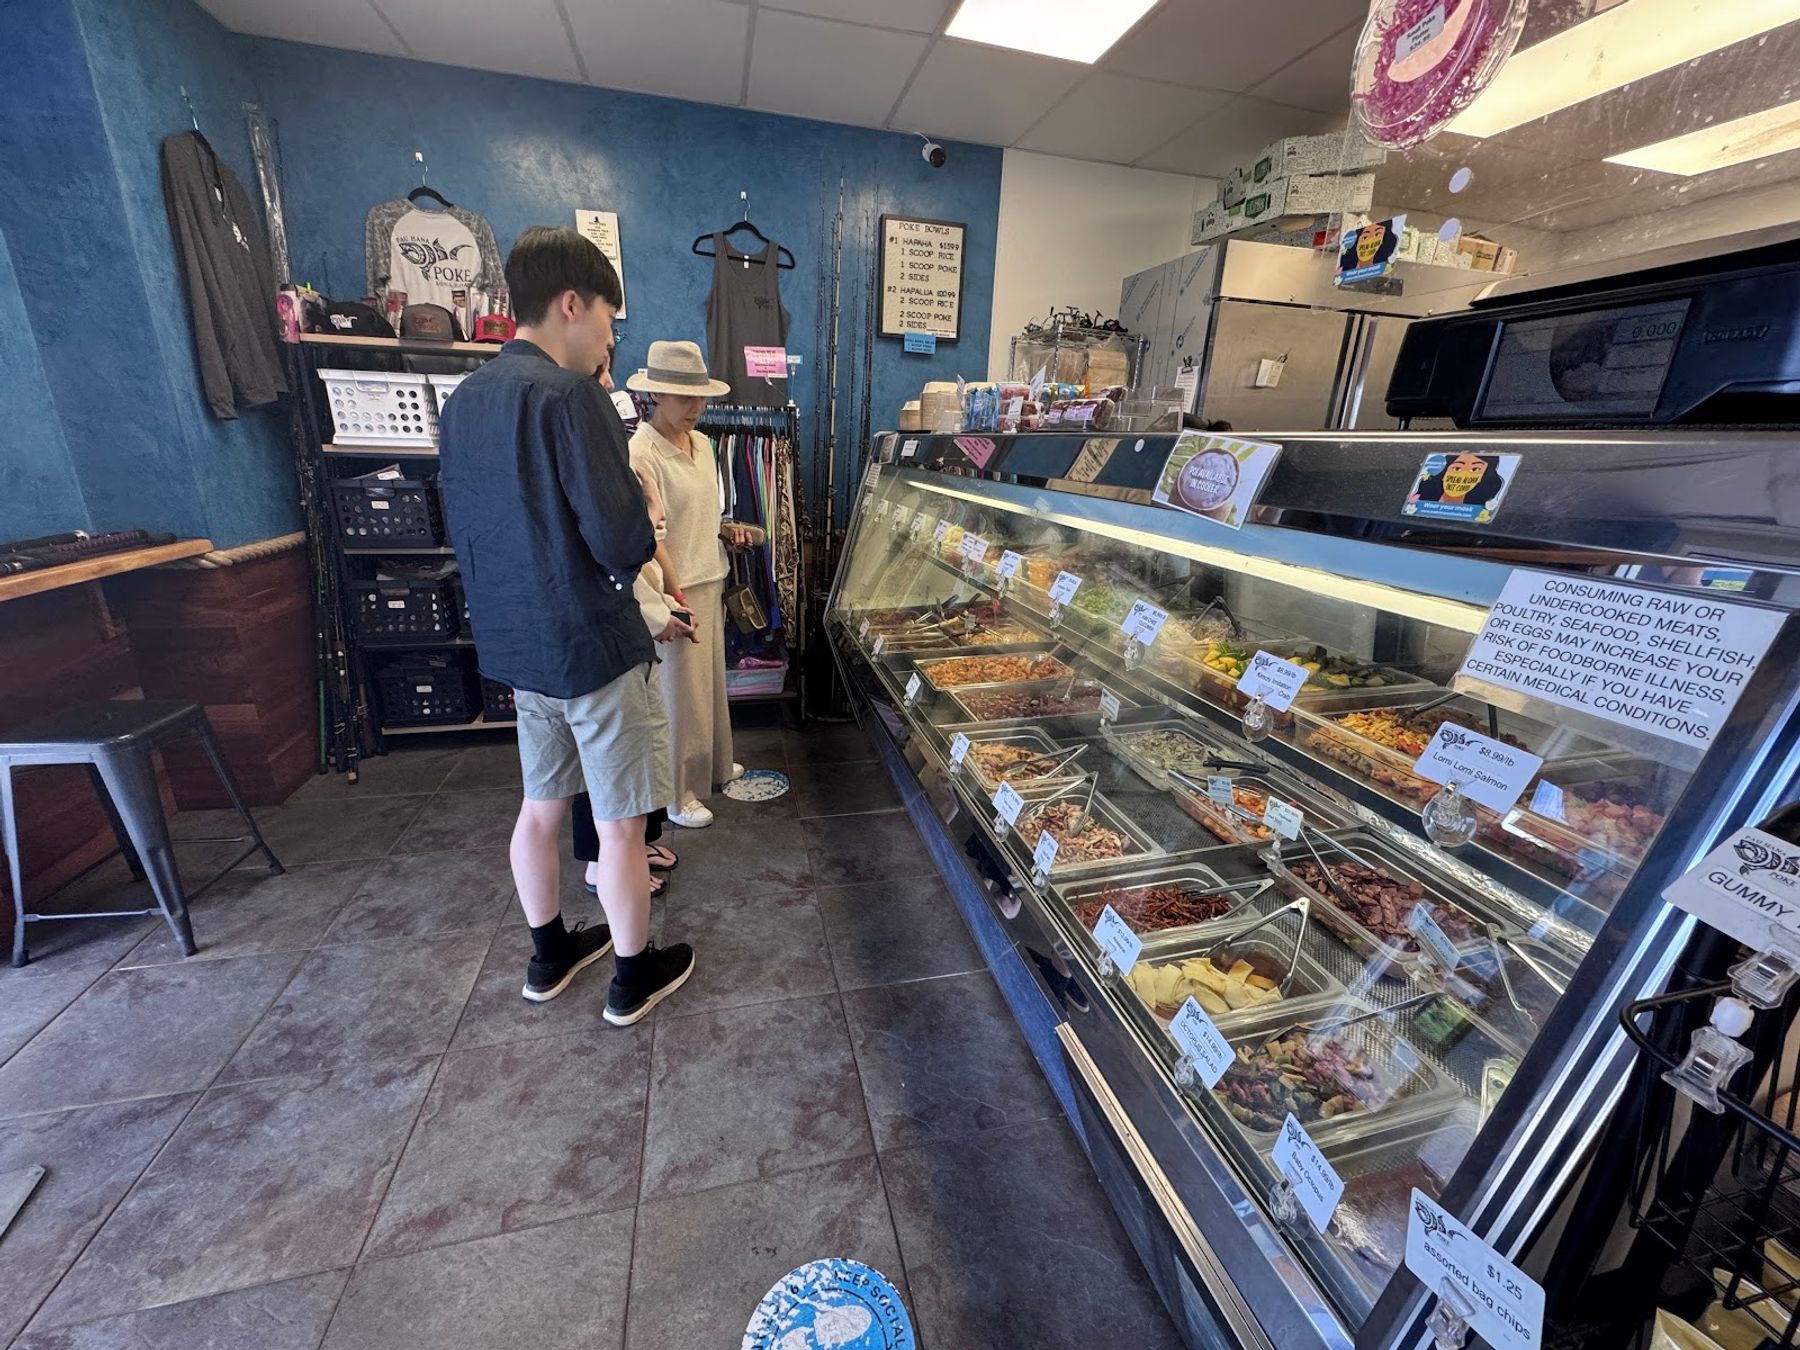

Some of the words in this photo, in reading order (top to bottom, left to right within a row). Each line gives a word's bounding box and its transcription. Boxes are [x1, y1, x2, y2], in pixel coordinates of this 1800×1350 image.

[898, 222, 920, 232] POKE
[924, 225, 950, 235] BOWLS
[901, 248, 905, 256] 1
[908, 248, 934, 258] SCOOP
[938, 252, 954, 261] RICE
[901, 260, 904, 268] 1
[908, 262, 934, 271] SCOOP
[938, 264, 958, 274] POKE
[433, 266, 472, 282] POKE
[900, 272, 905, 280] 2
[908, 274, 930, 282] SIDES
[900, 296, 905, 304] 2
[908, 297, 934, 306] SCOOP
[937, 300, 954, 308] RICE
[900, 310, 904, 318] 2
[906, 311, 932, 320] SCOOP
[934, 314, 952, 322] POKE
[899, 320, 904, 328] 2
[906, 321, 927, 330] SIDES
[1632, 321, 1677, 339] 0.000
[1528, 593, 1659, 627] UNDERCOOKED
[1655, 618, 1722, 642] MEATS,
[1544, 580, 1645, 607] CONSUMING
[1647, 597, 1695, 617] RAW
[1695, 605, 1725, 621] OR
[1490, 617, 1515, 631] OR
[1515, 621, 1553, 641] EGGS
[1555, 632, 1590, 649] MAY
[1592, 642, 1680, 671] INCREASE
[1686, 660, 1744, 687] YOUR
[1494, 602, 1557, 627] POULTRY,
[1560, 618, 1640, 646] SEAFOOD,
[1647, 636, 1756, 670] SHELLFISH,
[1482, 631, 1515, 648] RISK
[1517, 640, 1537, 653] OF
[1540, 645, 1643, 682] FOODBORNE
[1644, 672, 1727, 705] ILLNESS,
[1494, 650, 1581, 683] ESPECIALLY
[1582, 673, 1599, 687] IF
[1601, 677, 1639, 700] YOU
[1643, 689, 1692, 714] HAVE
[1278, 690, 1291, 701] Crab
[1466, 658, 1523, 684] CERTAIN
[1525, 674, 1590, 705] MEDICAL
[1594, 696, 1711, 741] CONDITIONS.
[1432, 752, 1453, 767] Lomi
[1453, 761, 1474, 776] Lomi
[1474, 771, 1508, 791] Salmon
[1478, 746, 1516, 768] $8.99/lb
[1708, 871, 1794, 917] GUMMY
[1769, 872, 1798, 888] POKE
[1180, 1020, 1203, 1053] OCTOPUS
[1201, 1050, 1218, 1074] SALAD
[1292, 1152, 1304, 1172] Baby
[1304, 1170, 1324, 1202] Octopus
[1310, 1154, 1335, 1192] $14.99/lb
[1424, 1242, 1470, 1286] assorted
[1472, 1280, 1494, 1309] bag
[1497, 1305, 1531, 1341] chips
[1486, 1264, 1523, 1301] $1.25
[870, 1286, 906, 1350] SOCIAL
